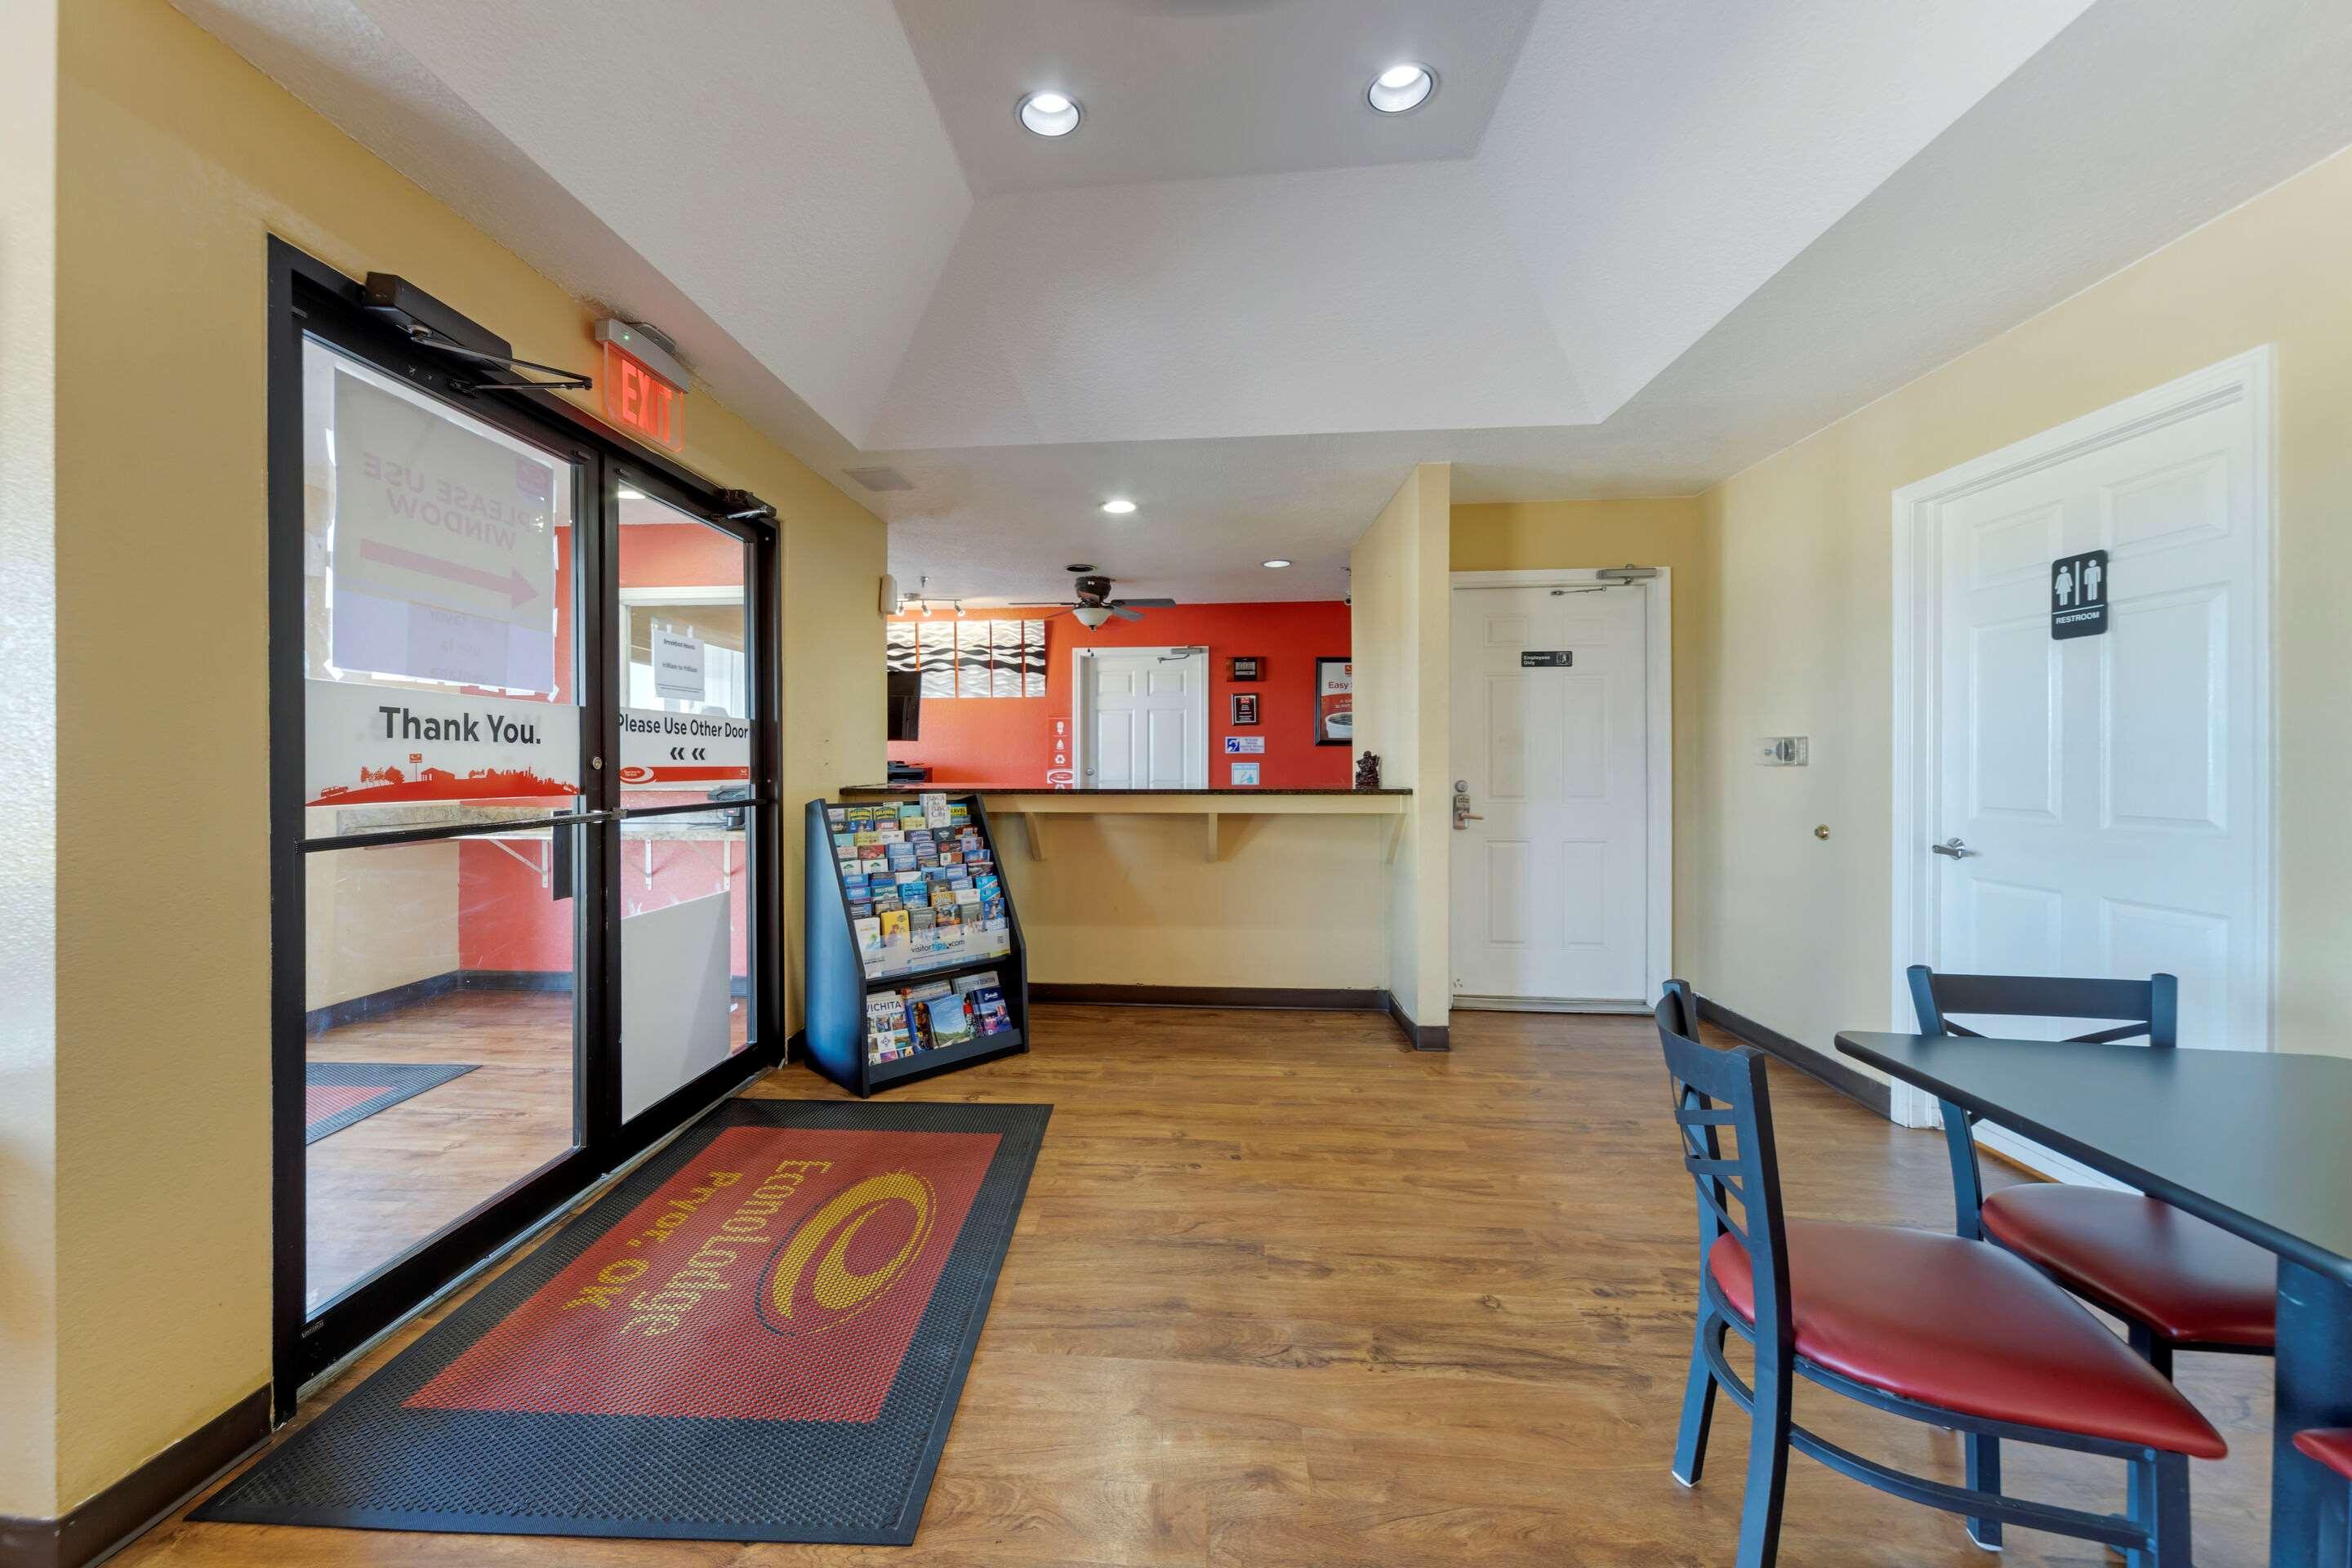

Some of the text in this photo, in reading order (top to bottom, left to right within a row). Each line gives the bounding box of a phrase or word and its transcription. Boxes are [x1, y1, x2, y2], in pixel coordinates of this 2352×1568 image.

[621, 359, 673, 443] EXIT
[2056, 612, 2100, 624] RESTROOM
[1328, 681, 1348, 689] Easy
[379, 706, 541, 744] Thank You.
[664, 717, 687, 735] Use
[690, 719, 722, 737] Other
[725, 722, 749, 738] Door
[560, 1258, 650, 1311] OK
